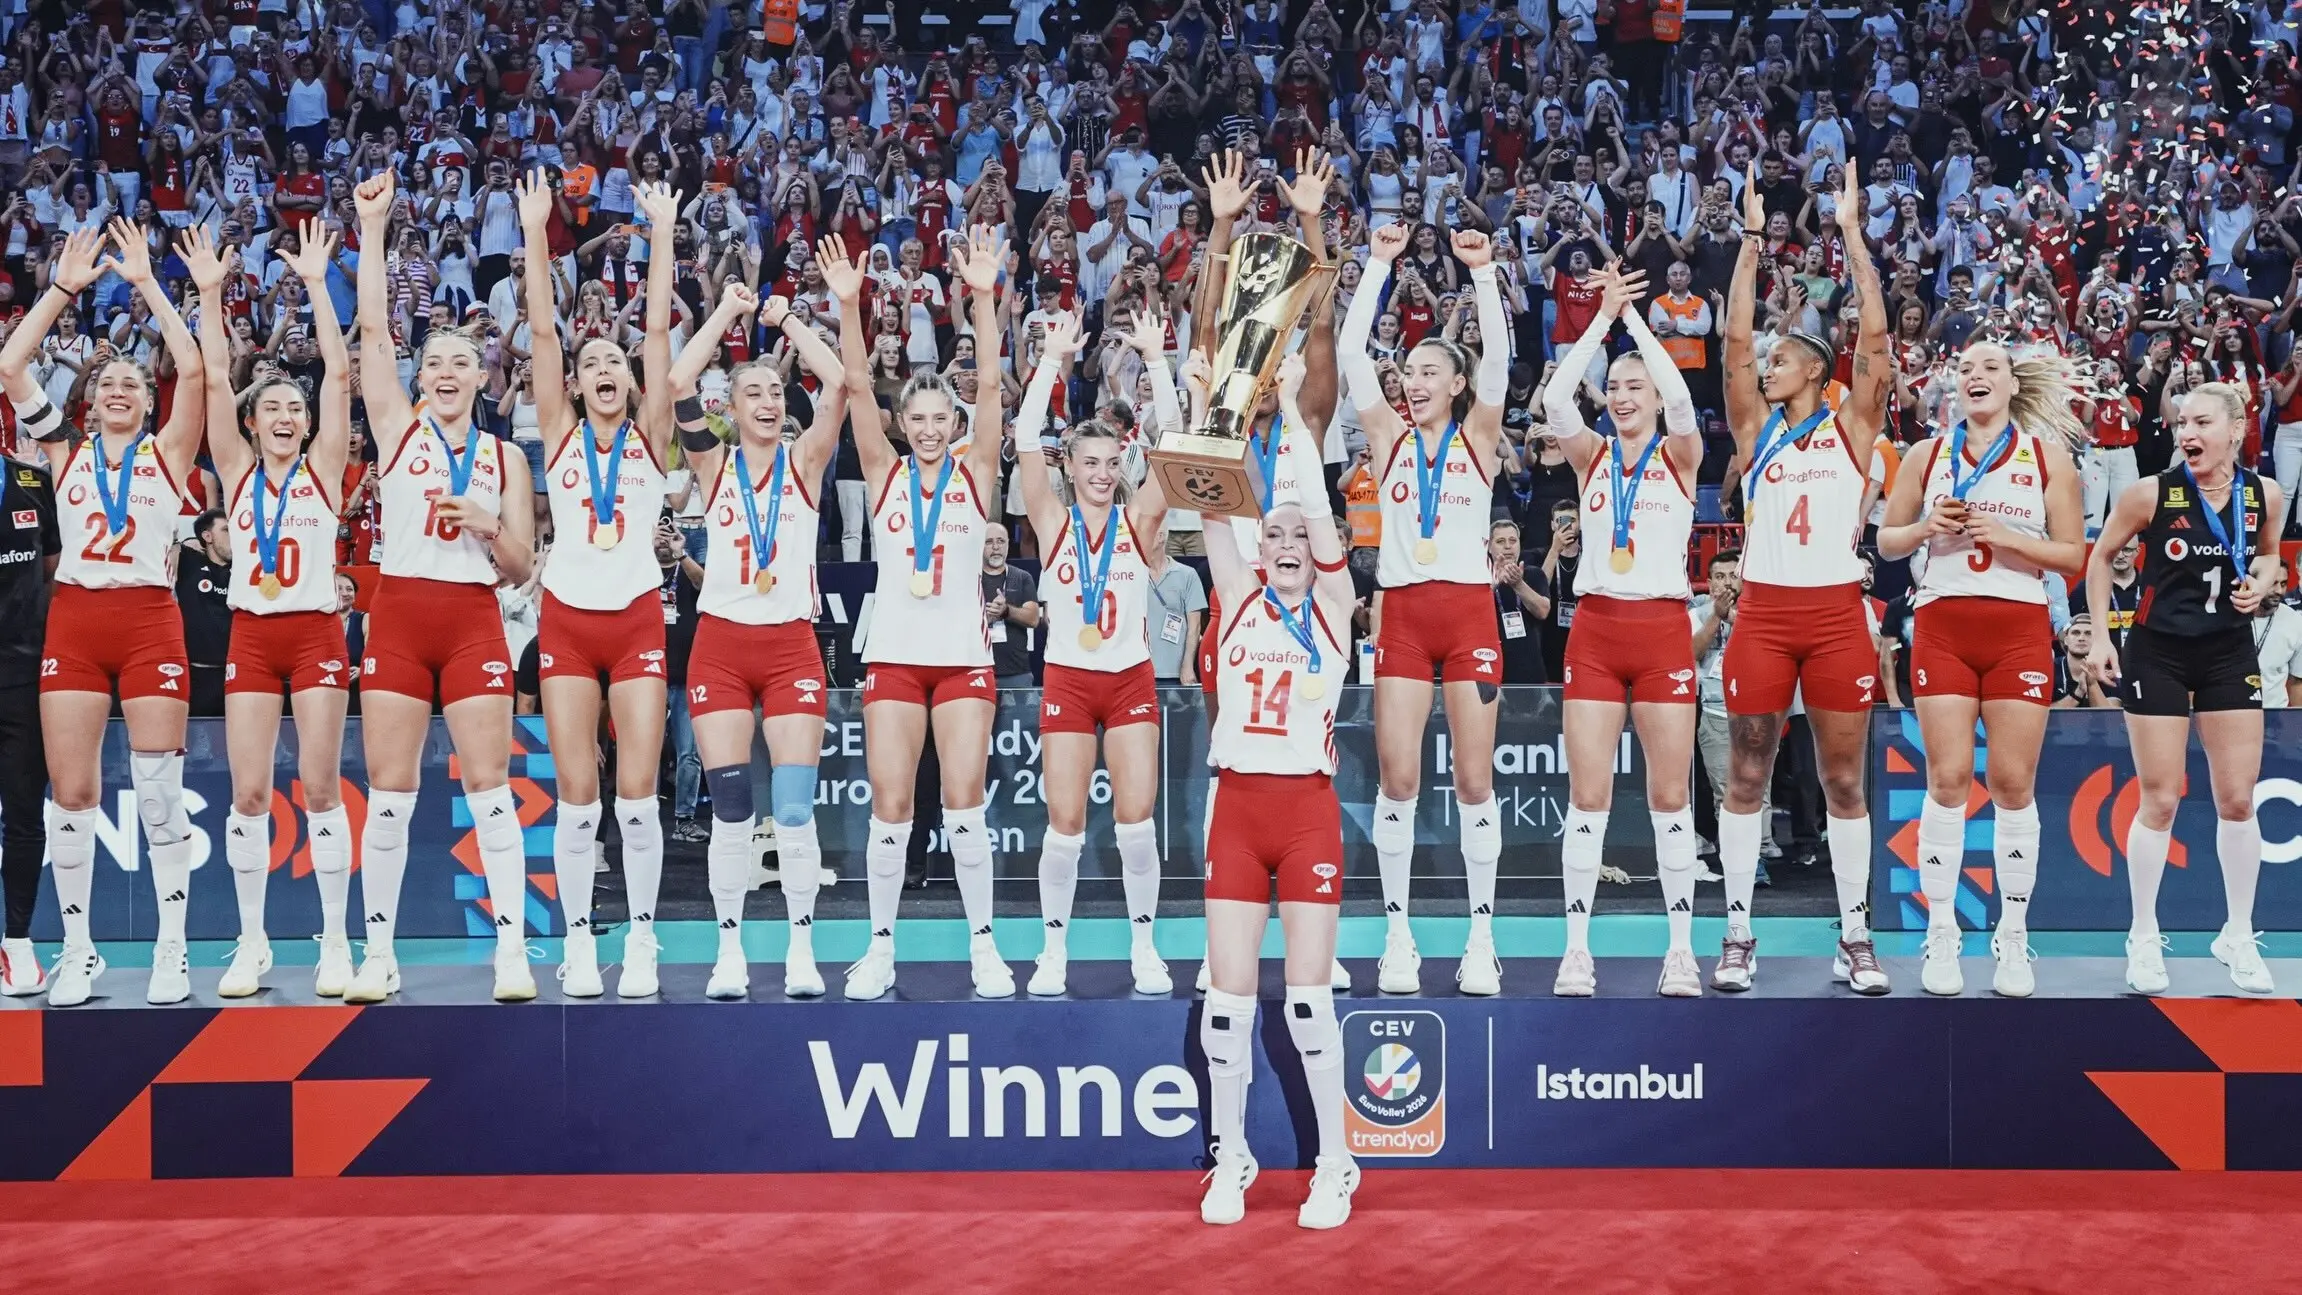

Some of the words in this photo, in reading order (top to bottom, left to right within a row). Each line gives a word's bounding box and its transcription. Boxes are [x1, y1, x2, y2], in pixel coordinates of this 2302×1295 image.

[932, 101, 940, 116] 4
[110, 126, 119, 137] 19
[410, 126, 426, 142] 22
[918, 142, 926, 157] 4
[166, 175, 174, 191] 4
[233, 178, 249, 193] 22
[922, 210, 930, 227] 4
[1184, 467, 1216, 478] CEV
[1786, 494, 1811, 546] 4
[81, 511, 137, 564] 22
[2202, 565, 2222, 613] 1
[540, 653, 553, 669] 15
[1205, 654, 1212, 672] 8
[1249, 651, 1309, 666] vodafon
[1378, 648, 1384, 664] 7
[42, 658, 58, 677] 22
[364, 657, 376, 676] 18
[1565, 666, 1572, 684] 6
[866, 673, 876, 691] 11
[1917, 669, 1928, 686] 3
[690, 681, 708, 704] 12
[1245, 668, 1292, 726] 14
[1730, 679, 1737, 697] 4
[2132, 681, 2142, 699] 1
[1369, 1020, 1415, 1036] CEV
[1537, 1063, 1703, 1101] Istanbul
[1358, 1094, 1405, 1118] EuroVolley
[1407, 1094, 1428, 1114] 2026
[1352, 1130, 1435, 1150] trendyol
